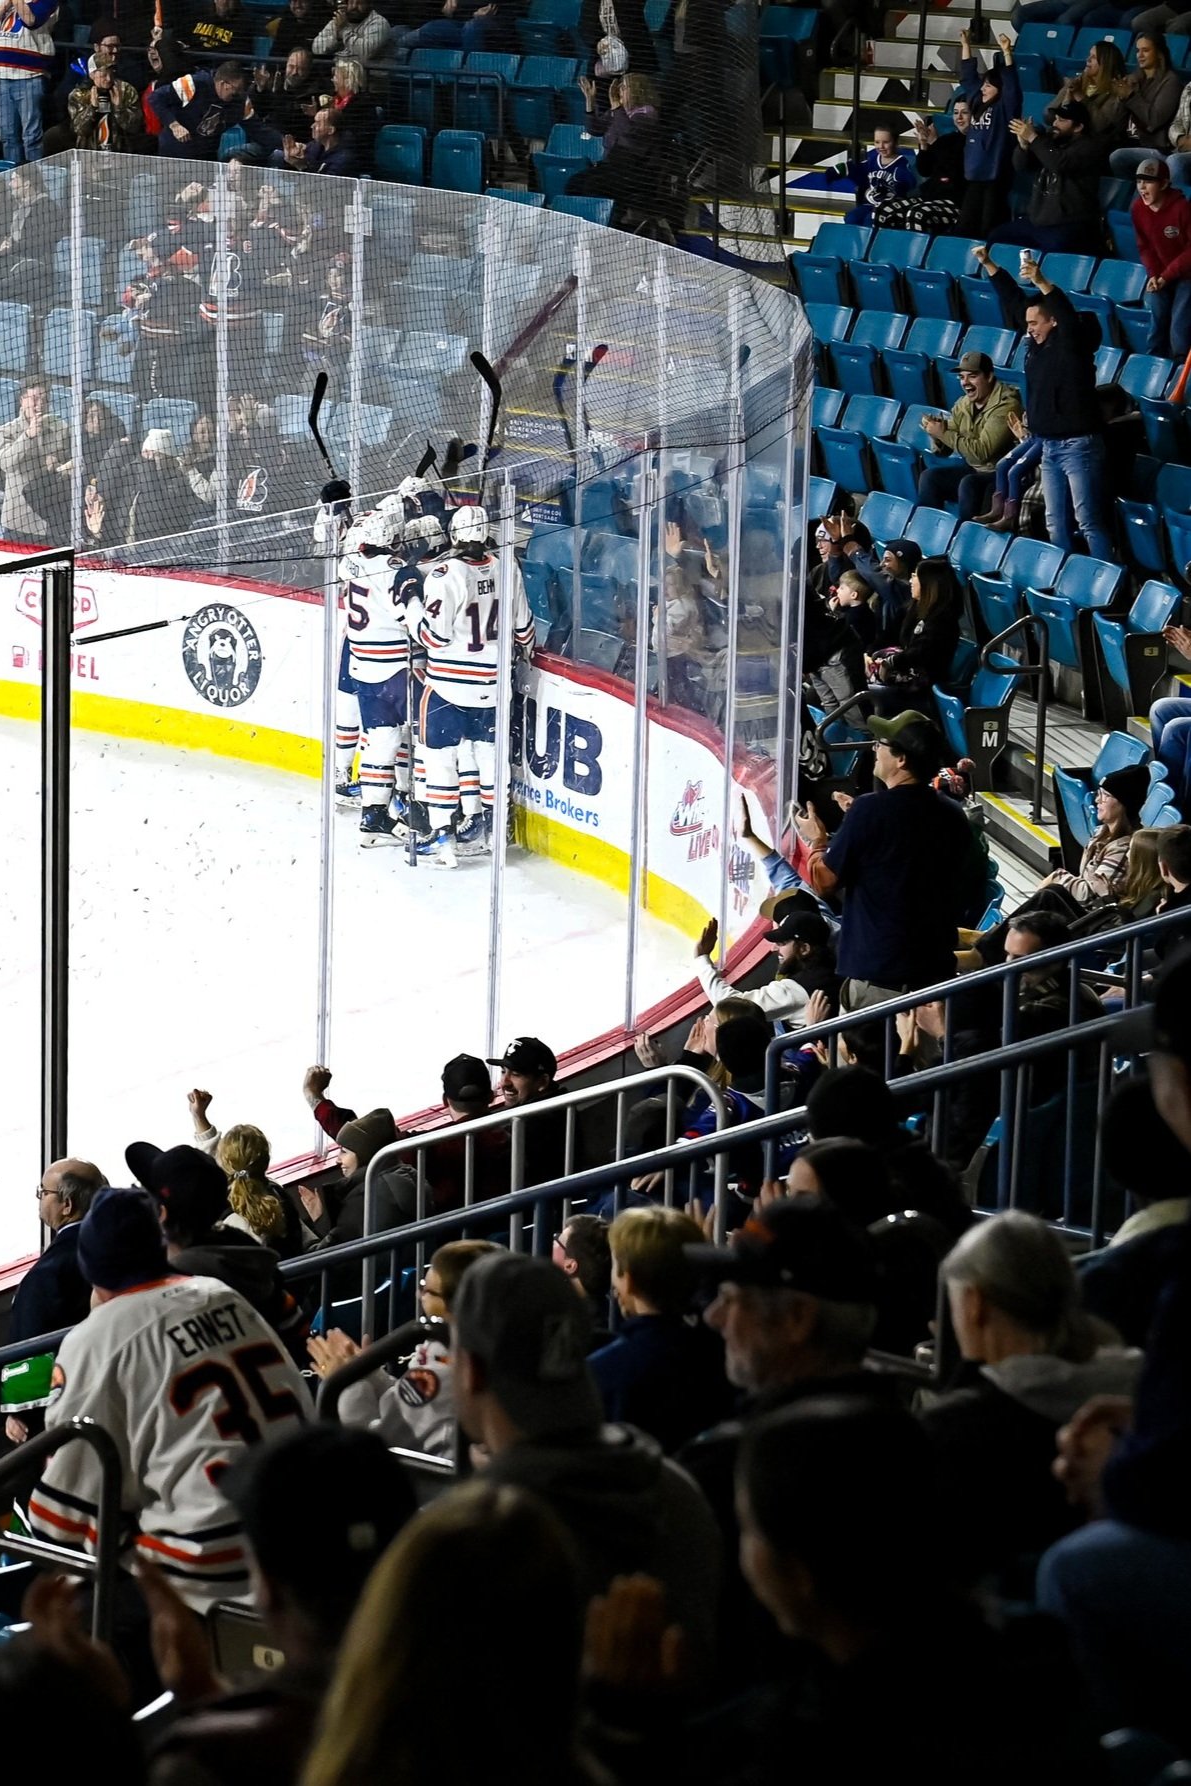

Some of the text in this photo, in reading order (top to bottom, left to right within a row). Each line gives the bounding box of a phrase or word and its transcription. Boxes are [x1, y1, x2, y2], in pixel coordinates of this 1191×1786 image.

[183, 607, 260, 661] ANGRY OTTER
[192, 670, 251, 703] LIQUOR
[981, 731, 999, 748] M
[545, 788, 600, 828] Brokers
[165, 1303, 247, 1360] ERNST
